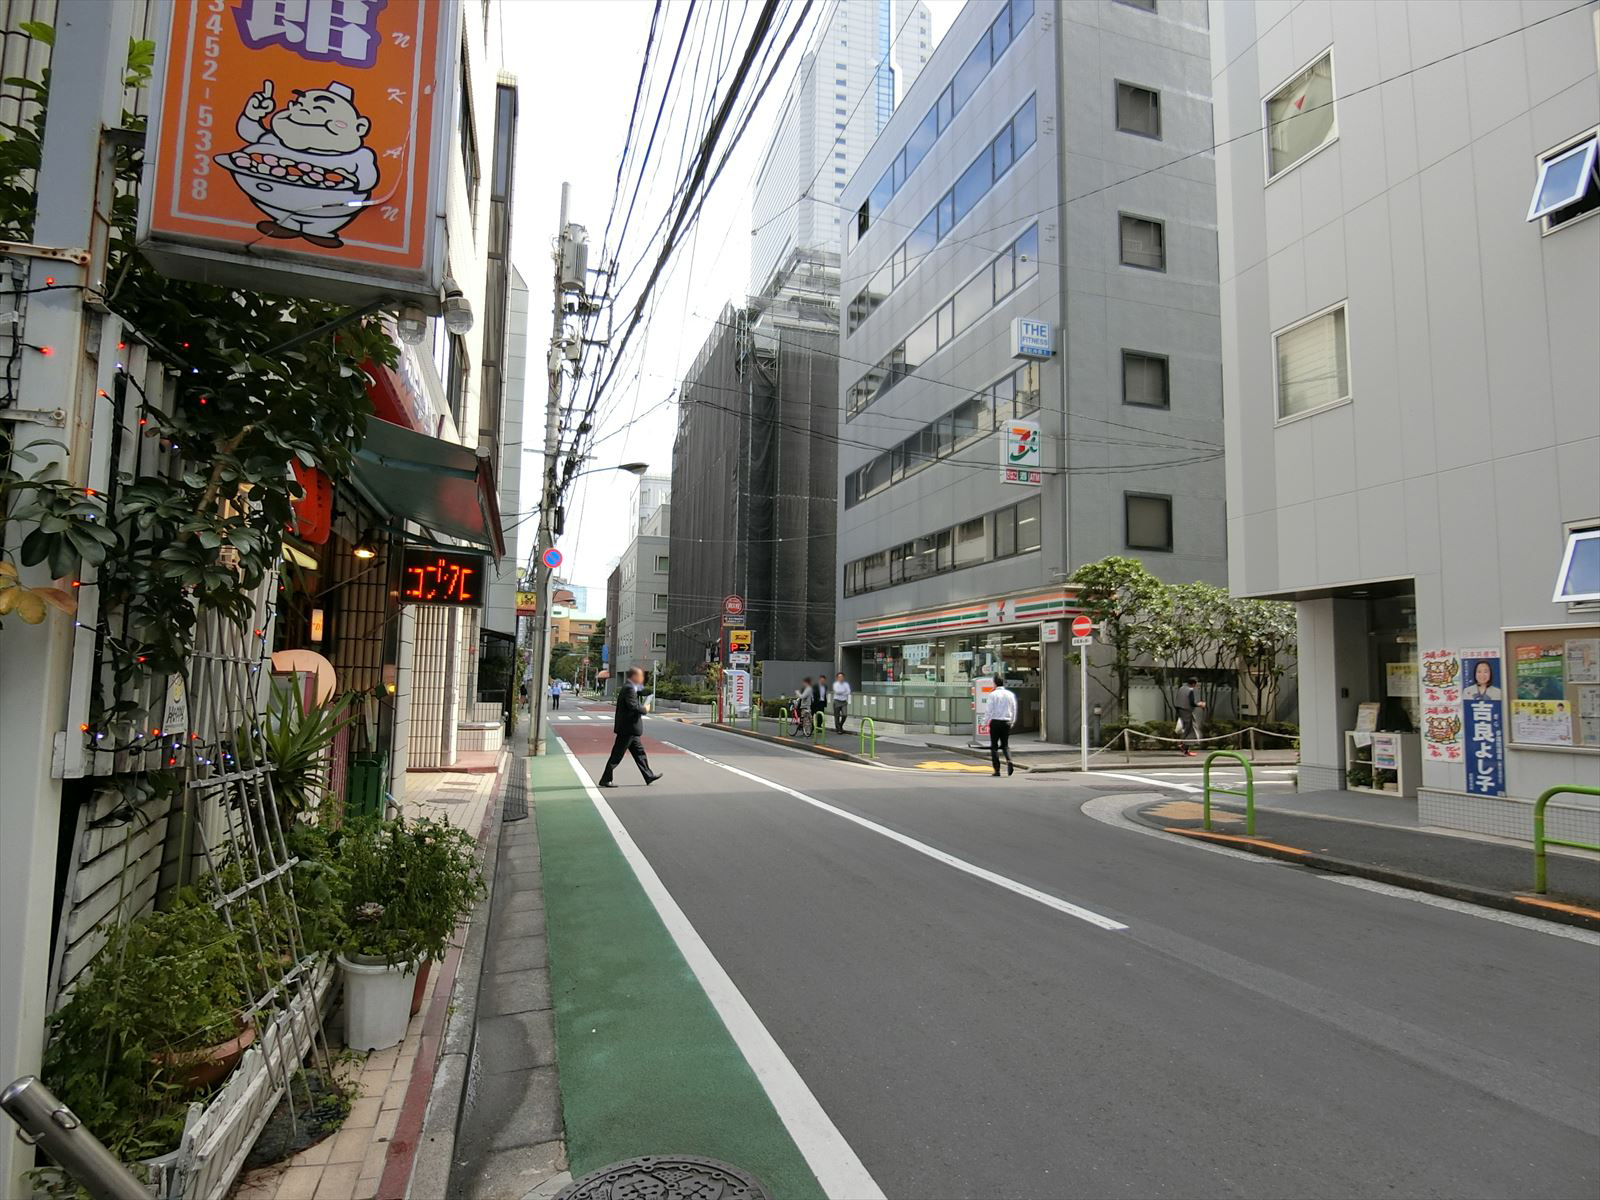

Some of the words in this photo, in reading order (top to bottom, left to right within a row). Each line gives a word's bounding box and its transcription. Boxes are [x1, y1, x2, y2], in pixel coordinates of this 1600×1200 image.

[1022, 321, 1048, 338] THE
[731, 643, 739, 653] P
[736, 674, 744, 703] KIRIN
[1471, 701, 1495, 792] 吉良よし子
